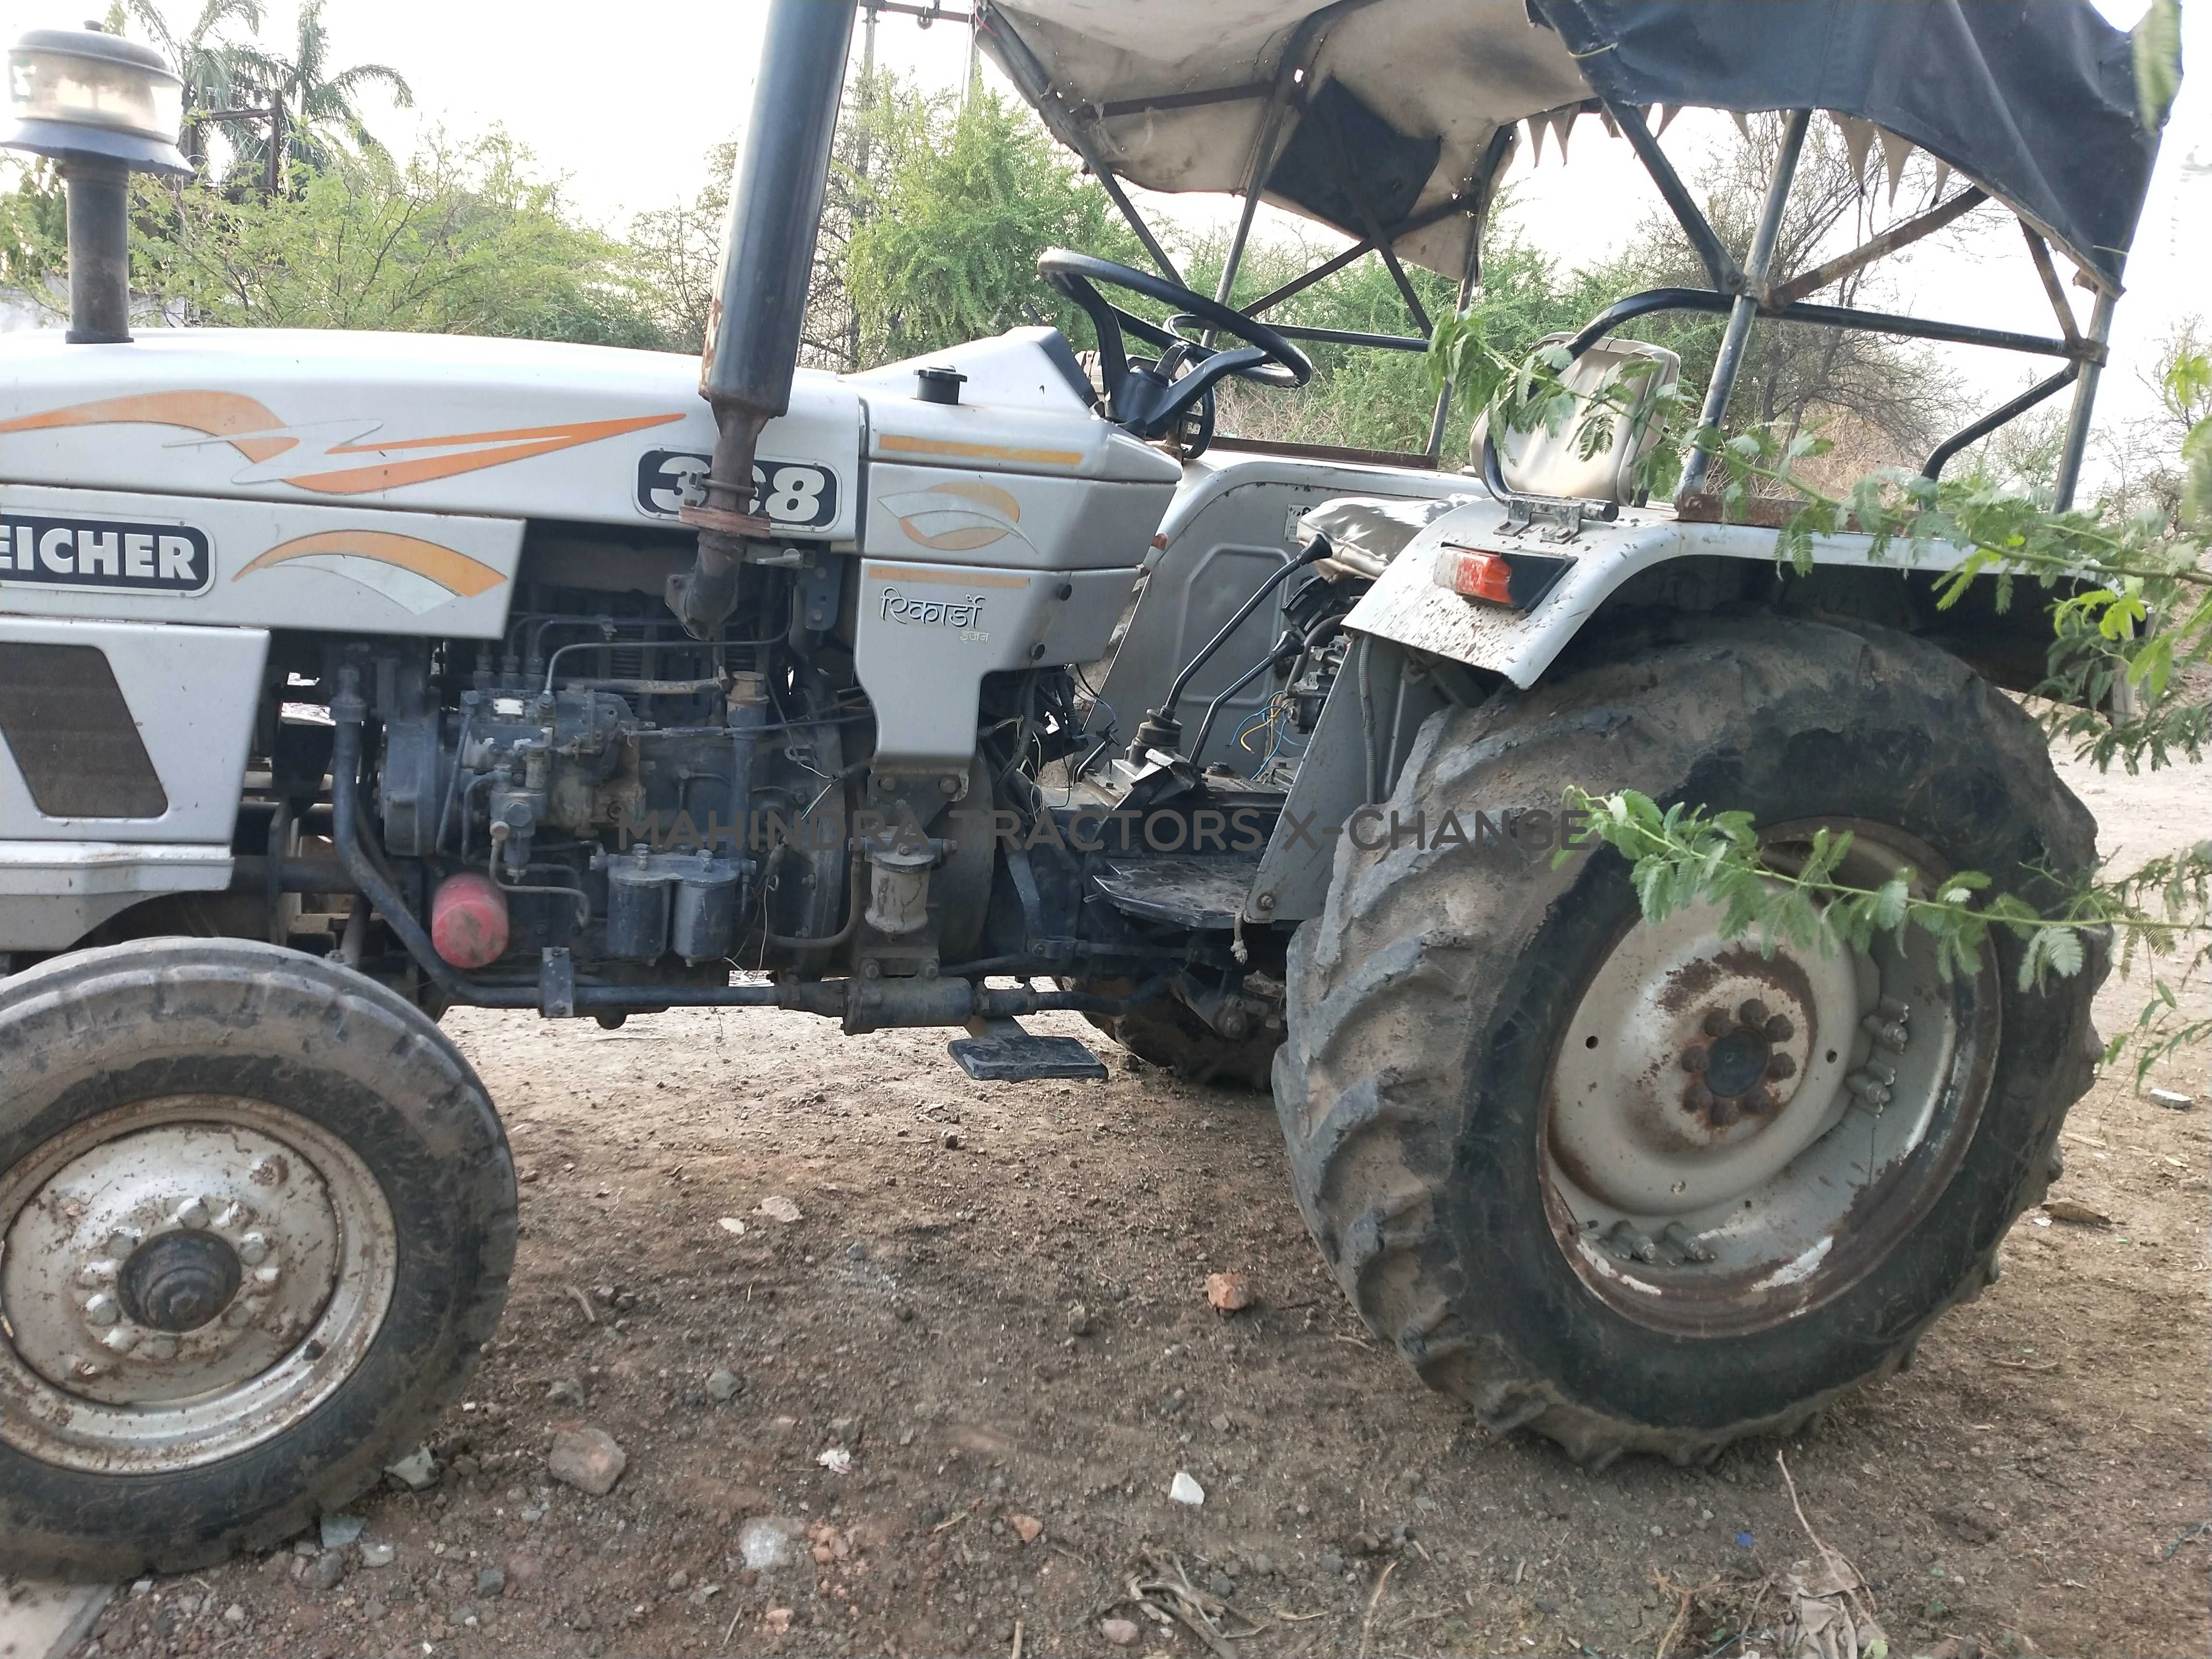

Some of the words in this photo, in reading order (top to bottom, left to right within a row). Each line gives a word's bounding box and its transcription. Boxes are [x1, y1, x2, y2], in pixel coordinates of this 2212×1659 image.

[650, 456, 826, 522] 38
[880, 586, 986, 629] रिकार्डो
[960, 628, 990, 644] इंजन
